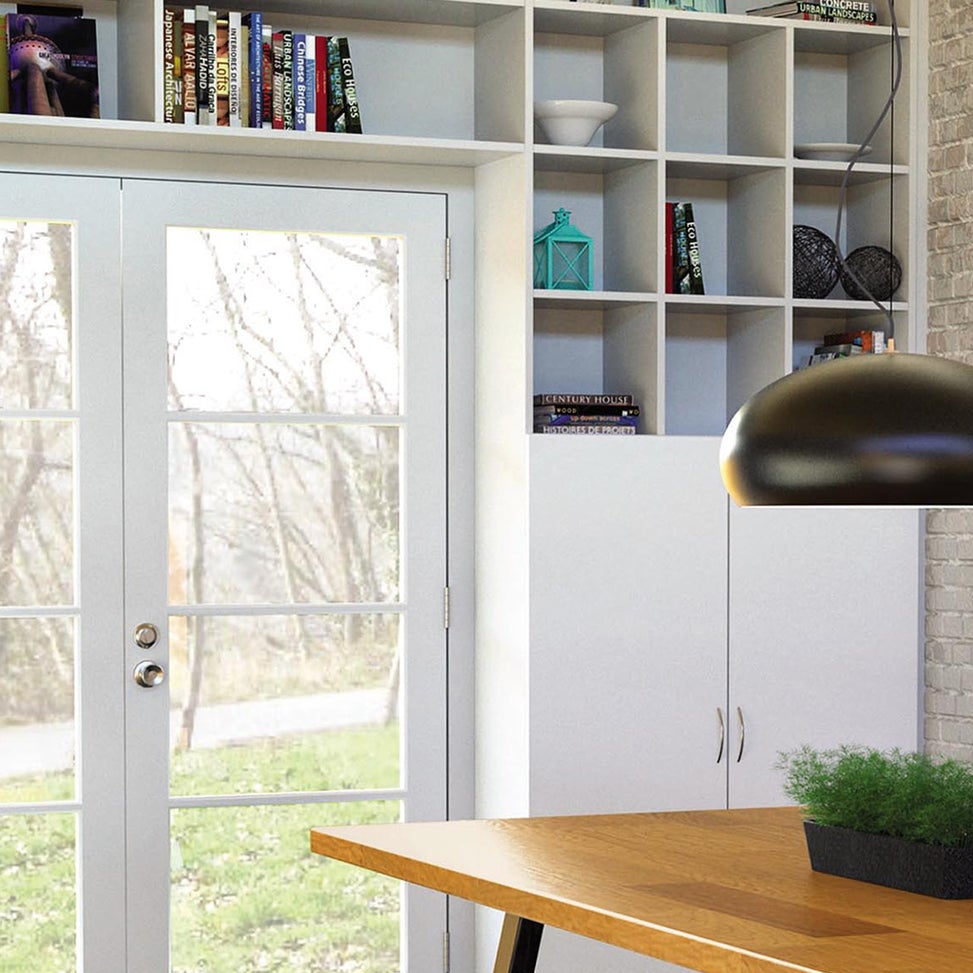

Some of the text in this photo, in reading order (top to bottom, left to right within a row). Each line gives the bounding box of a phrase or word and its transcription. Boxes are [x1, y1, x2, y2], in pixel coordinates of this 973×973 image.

[800, 3, 826, 15] URBAN
[828, 7, 874, 21] LANDSCAPES
[820, 0, 869, 11] CONCRETE
[164, 9, 175, 60] Japanese
[208, 34, 216, 70] Carrilho
[274, 46, 283, 70] Luis
[283, 33, 292, 69] URBAN
[184, 33, 196, 110] ALVAR AALTO
[208, 73, 216, 84] da
[216, 61, 229, 91] Lofts
[230, 73, 237, 82] DE
[295, 41, 306, 124] Chinese Bridges
[546, 395, 628, 404] CENTURY HOUSE
[543, 426, 586, 434] HISTOIRES
[588, 426, 599, 434] DE
